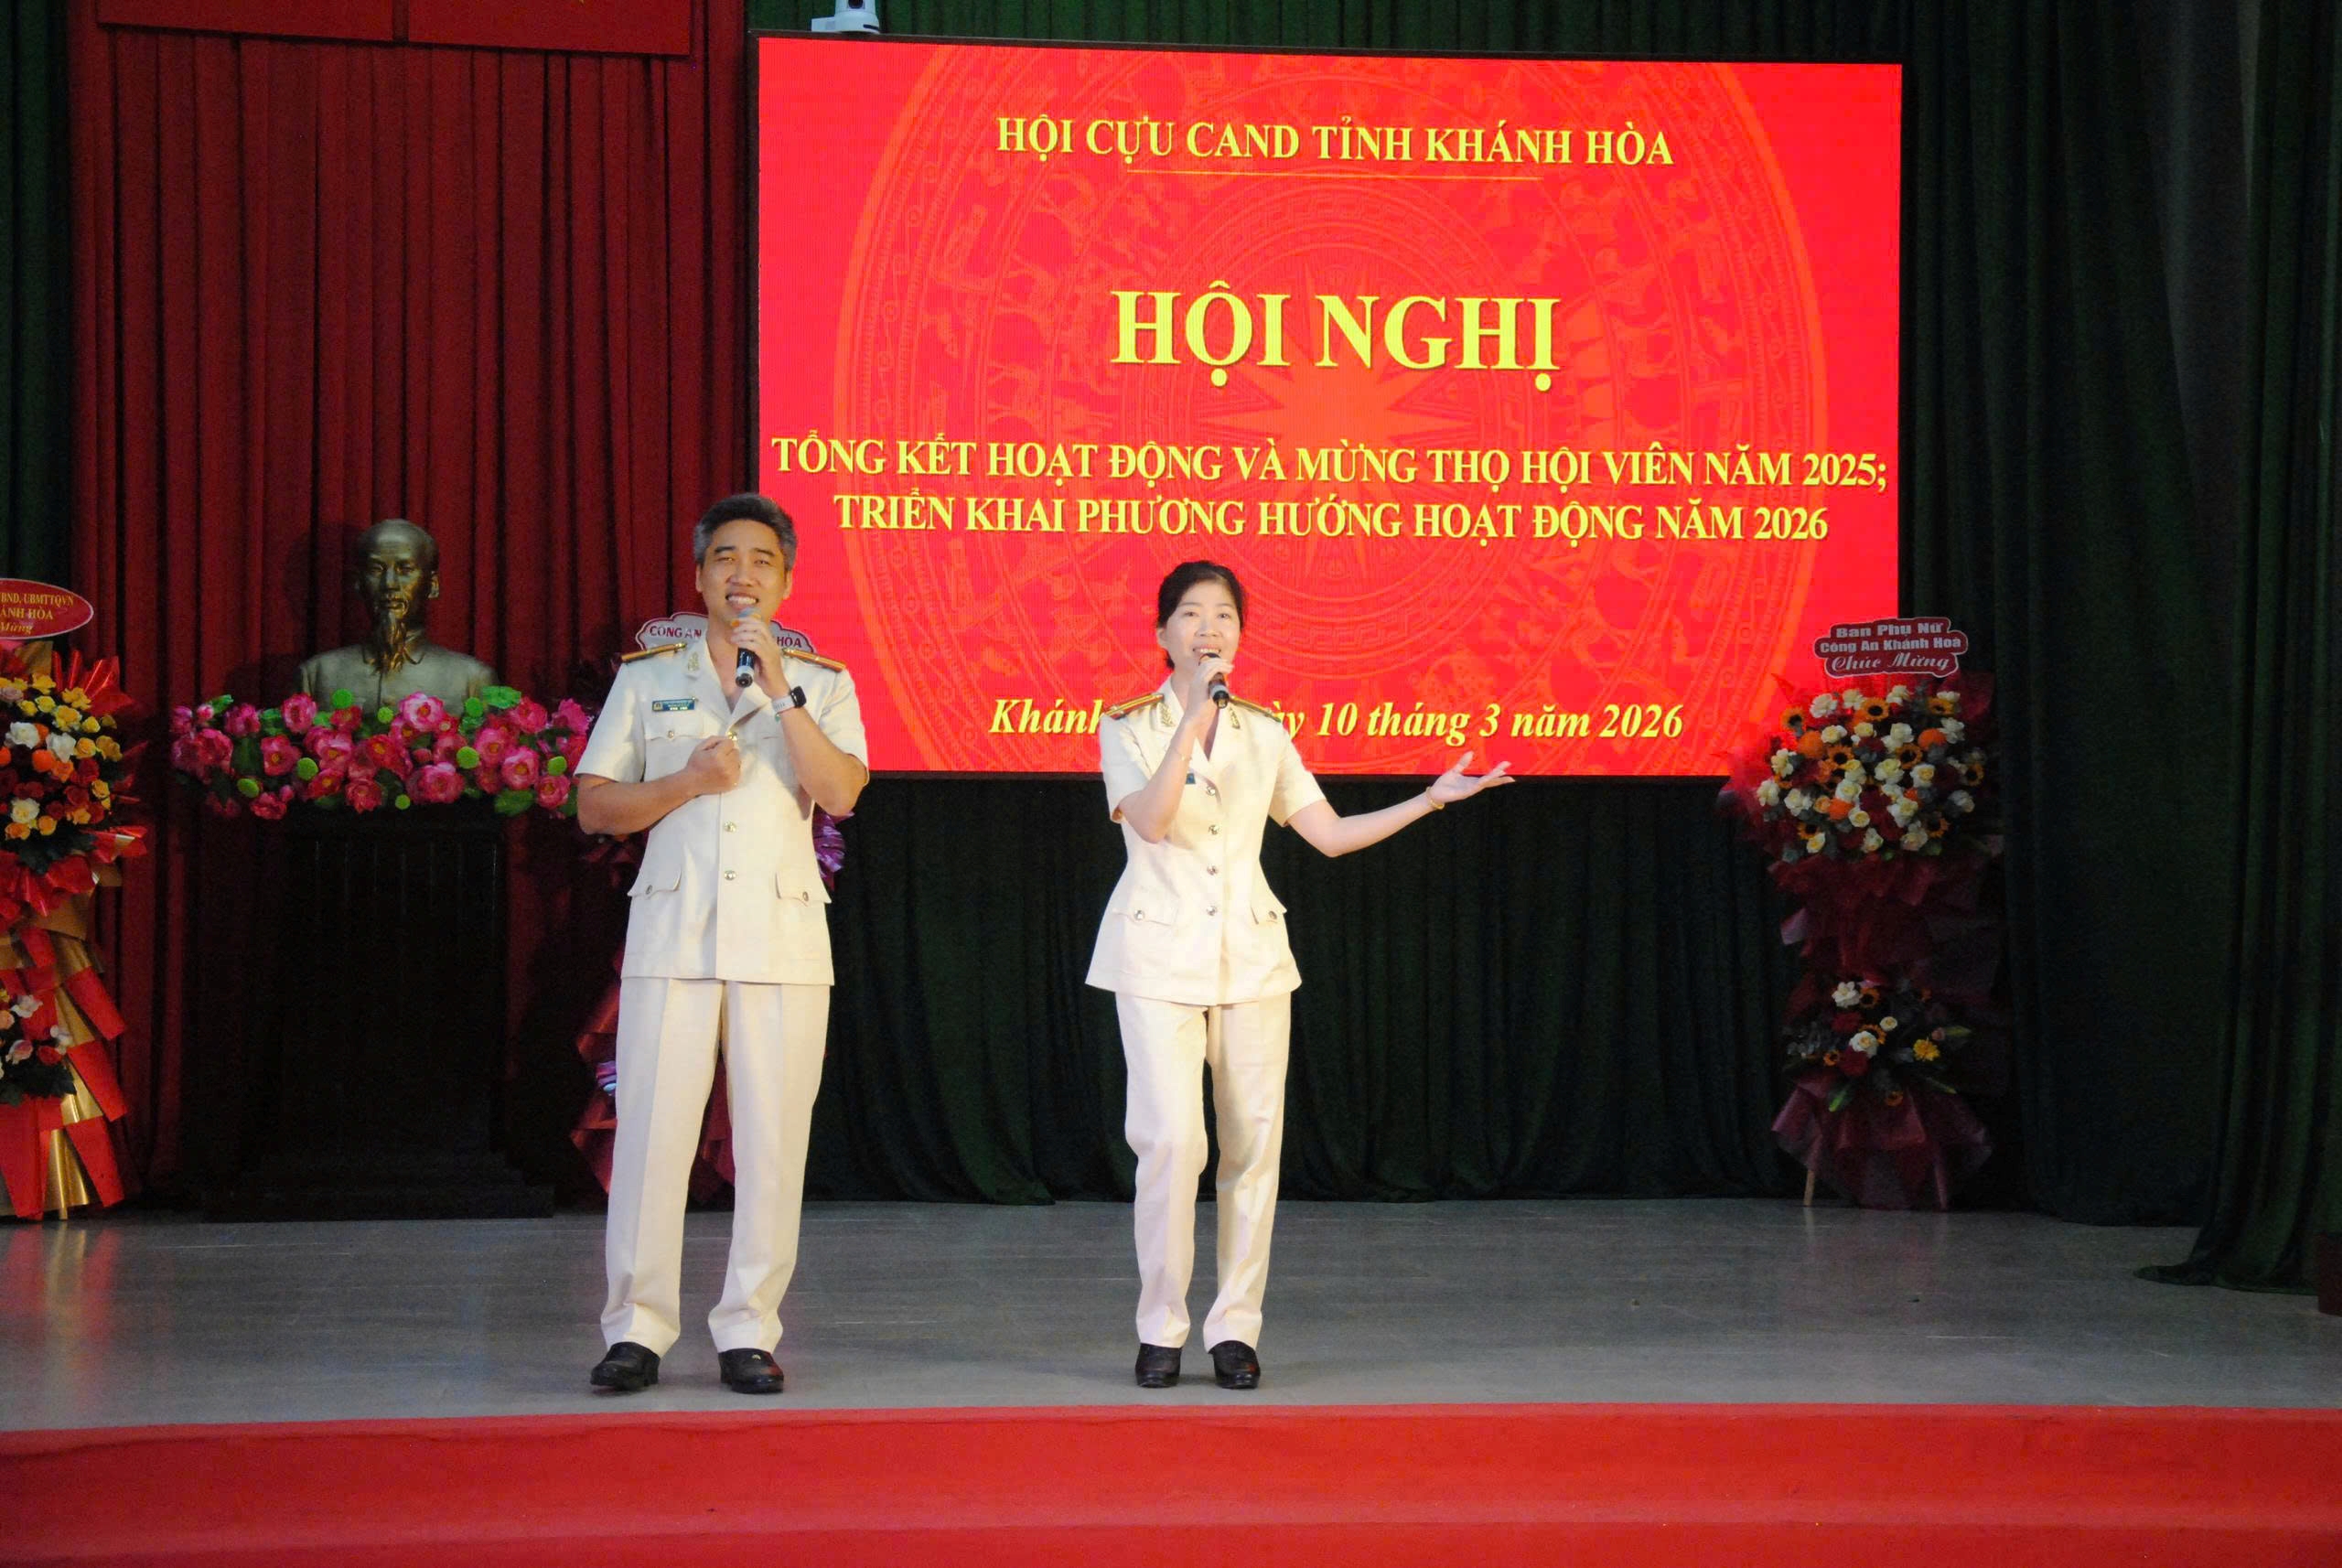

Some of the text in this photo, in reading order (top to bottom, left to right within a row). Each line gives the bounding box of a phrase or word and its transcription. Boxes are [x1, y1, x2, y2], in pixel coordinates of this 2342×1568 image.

[996, 113, 1674, 166] HỘI CỰU CAND TỈNH KHÁNH HÒA
[1110, 279, 1561, 392] HỘI NGHỊ
[771, 430, 1887, 492] TỔNG KẾT HOẠT ĐỘNG VÀ MỪNG THỌ HỘI VIÊN NĂM 2025;
[833, 487, 1828, 548] TRIỂN KHAI PHƯƠNG HƯỚNG HOẠT ĐỘNG NĂM 2026
[28, 606, 54, 620] HÒA
[684, 628, 702, 638] AN
[1836, 628, 1872, 638] Ban
[1877, 624, 1911, 637] Phụ
[1861, 640, 1879, 651] An
[1884, 638, 1929, 650] Khánh
[1316, 702, 1359, 736] 10
[1367, 702, 1471, 747] tháng
[1478, 703, 1501, 737] 3
[1510, 703, 1590, 737] năm
[1598, 703, 1684, 738] 2026
